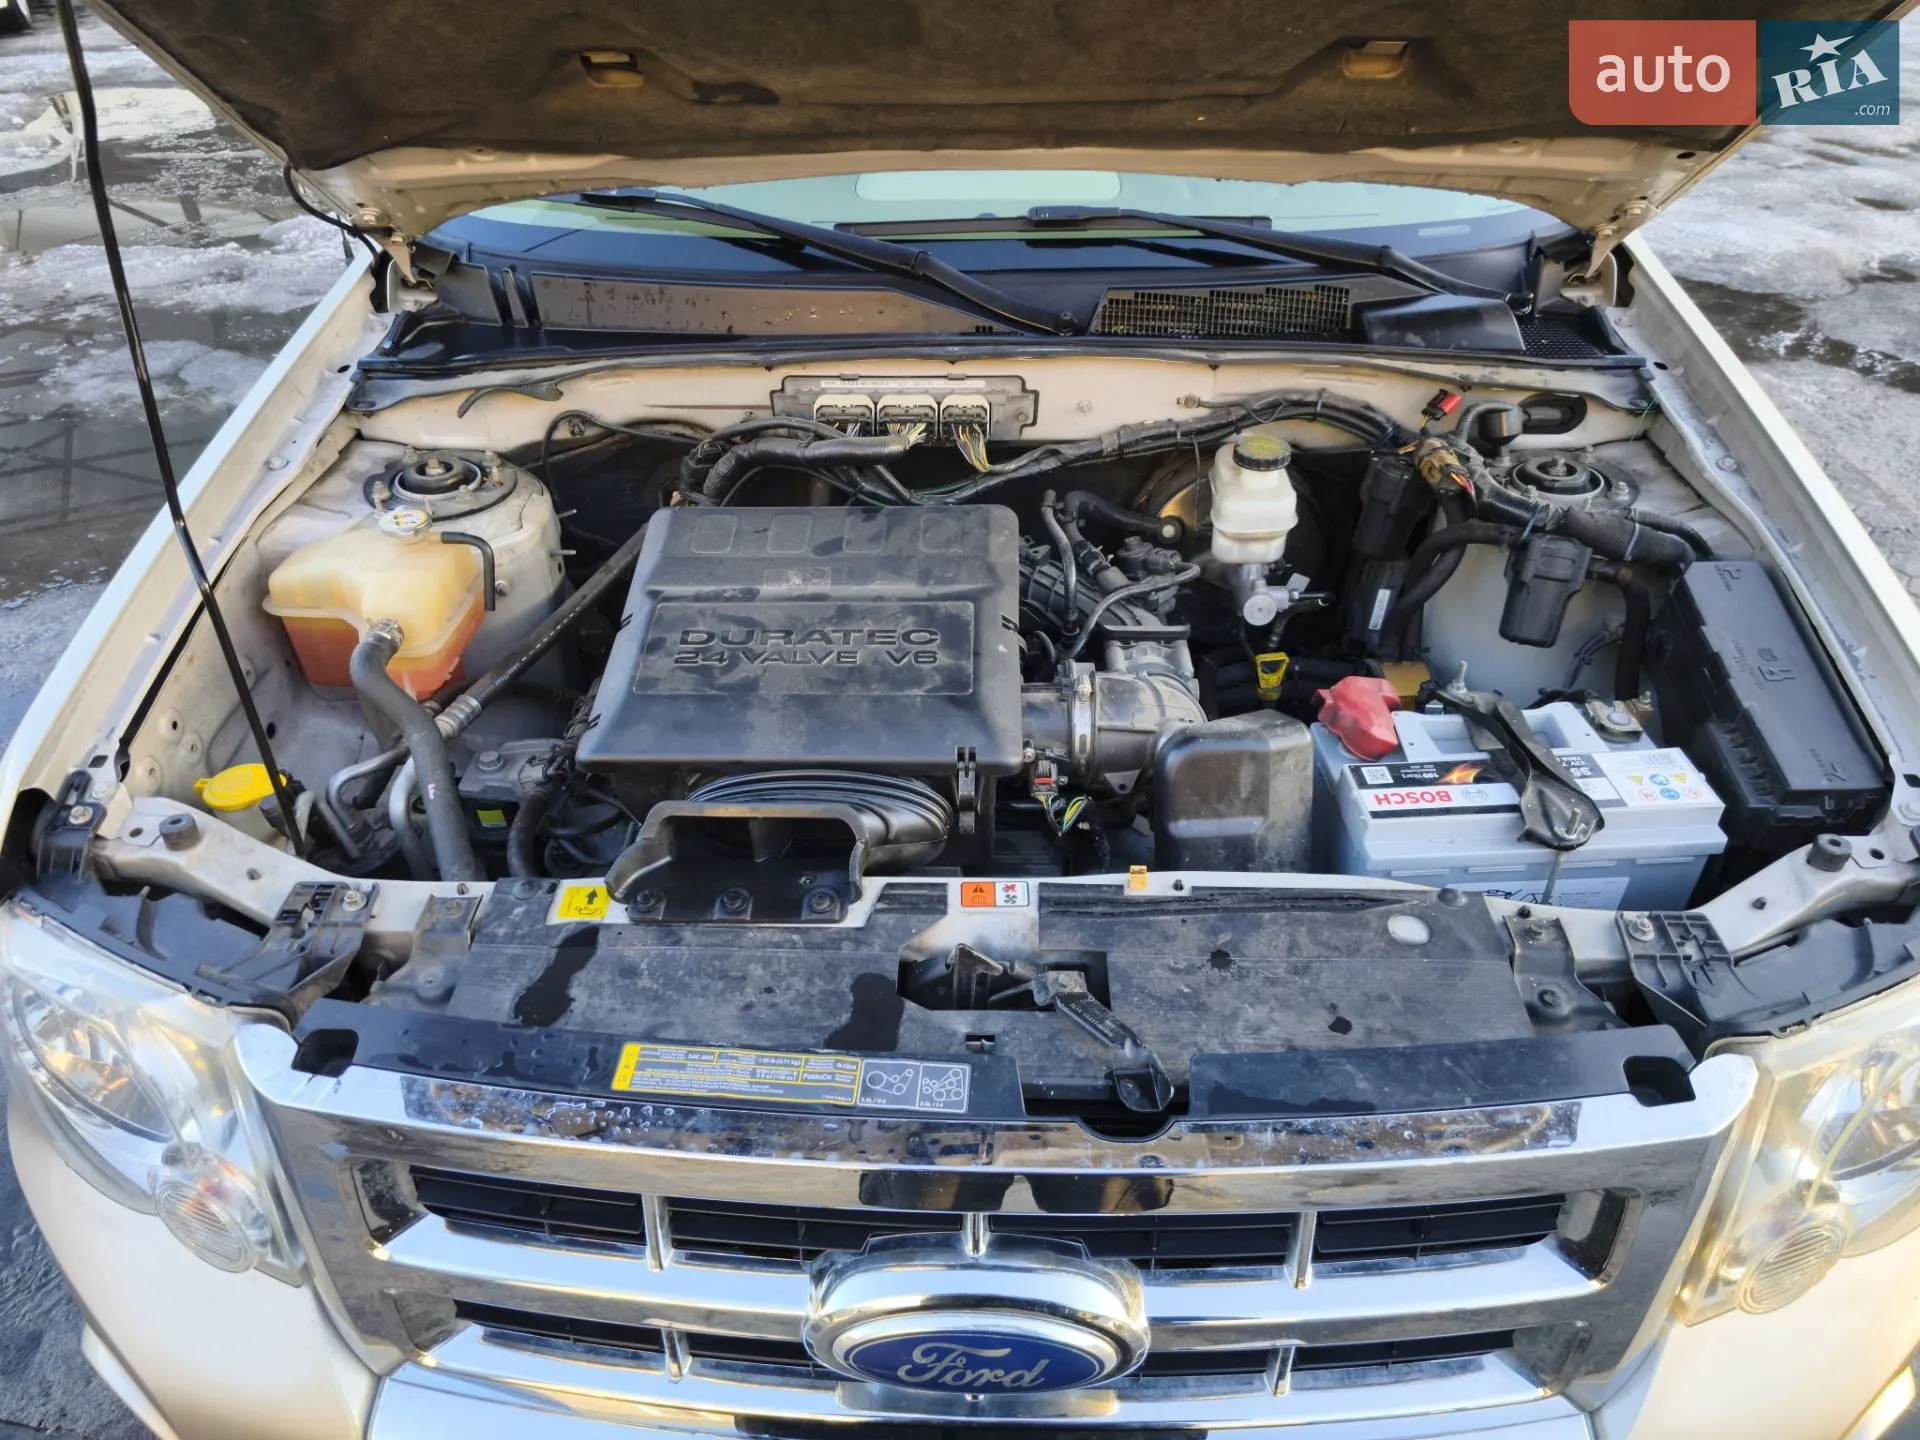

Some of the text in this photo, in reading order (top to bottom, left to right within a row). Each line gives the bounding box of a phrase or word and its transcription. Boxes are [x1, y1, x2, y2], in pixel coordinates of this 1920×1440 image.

[678, 628, 940, 647] DURATEC
[673, 650, 939, 666] 24 VALVE V6
[1374, 790, 1453, 806] BOSCH
[897, 1342, 1049, 1388] Ford
